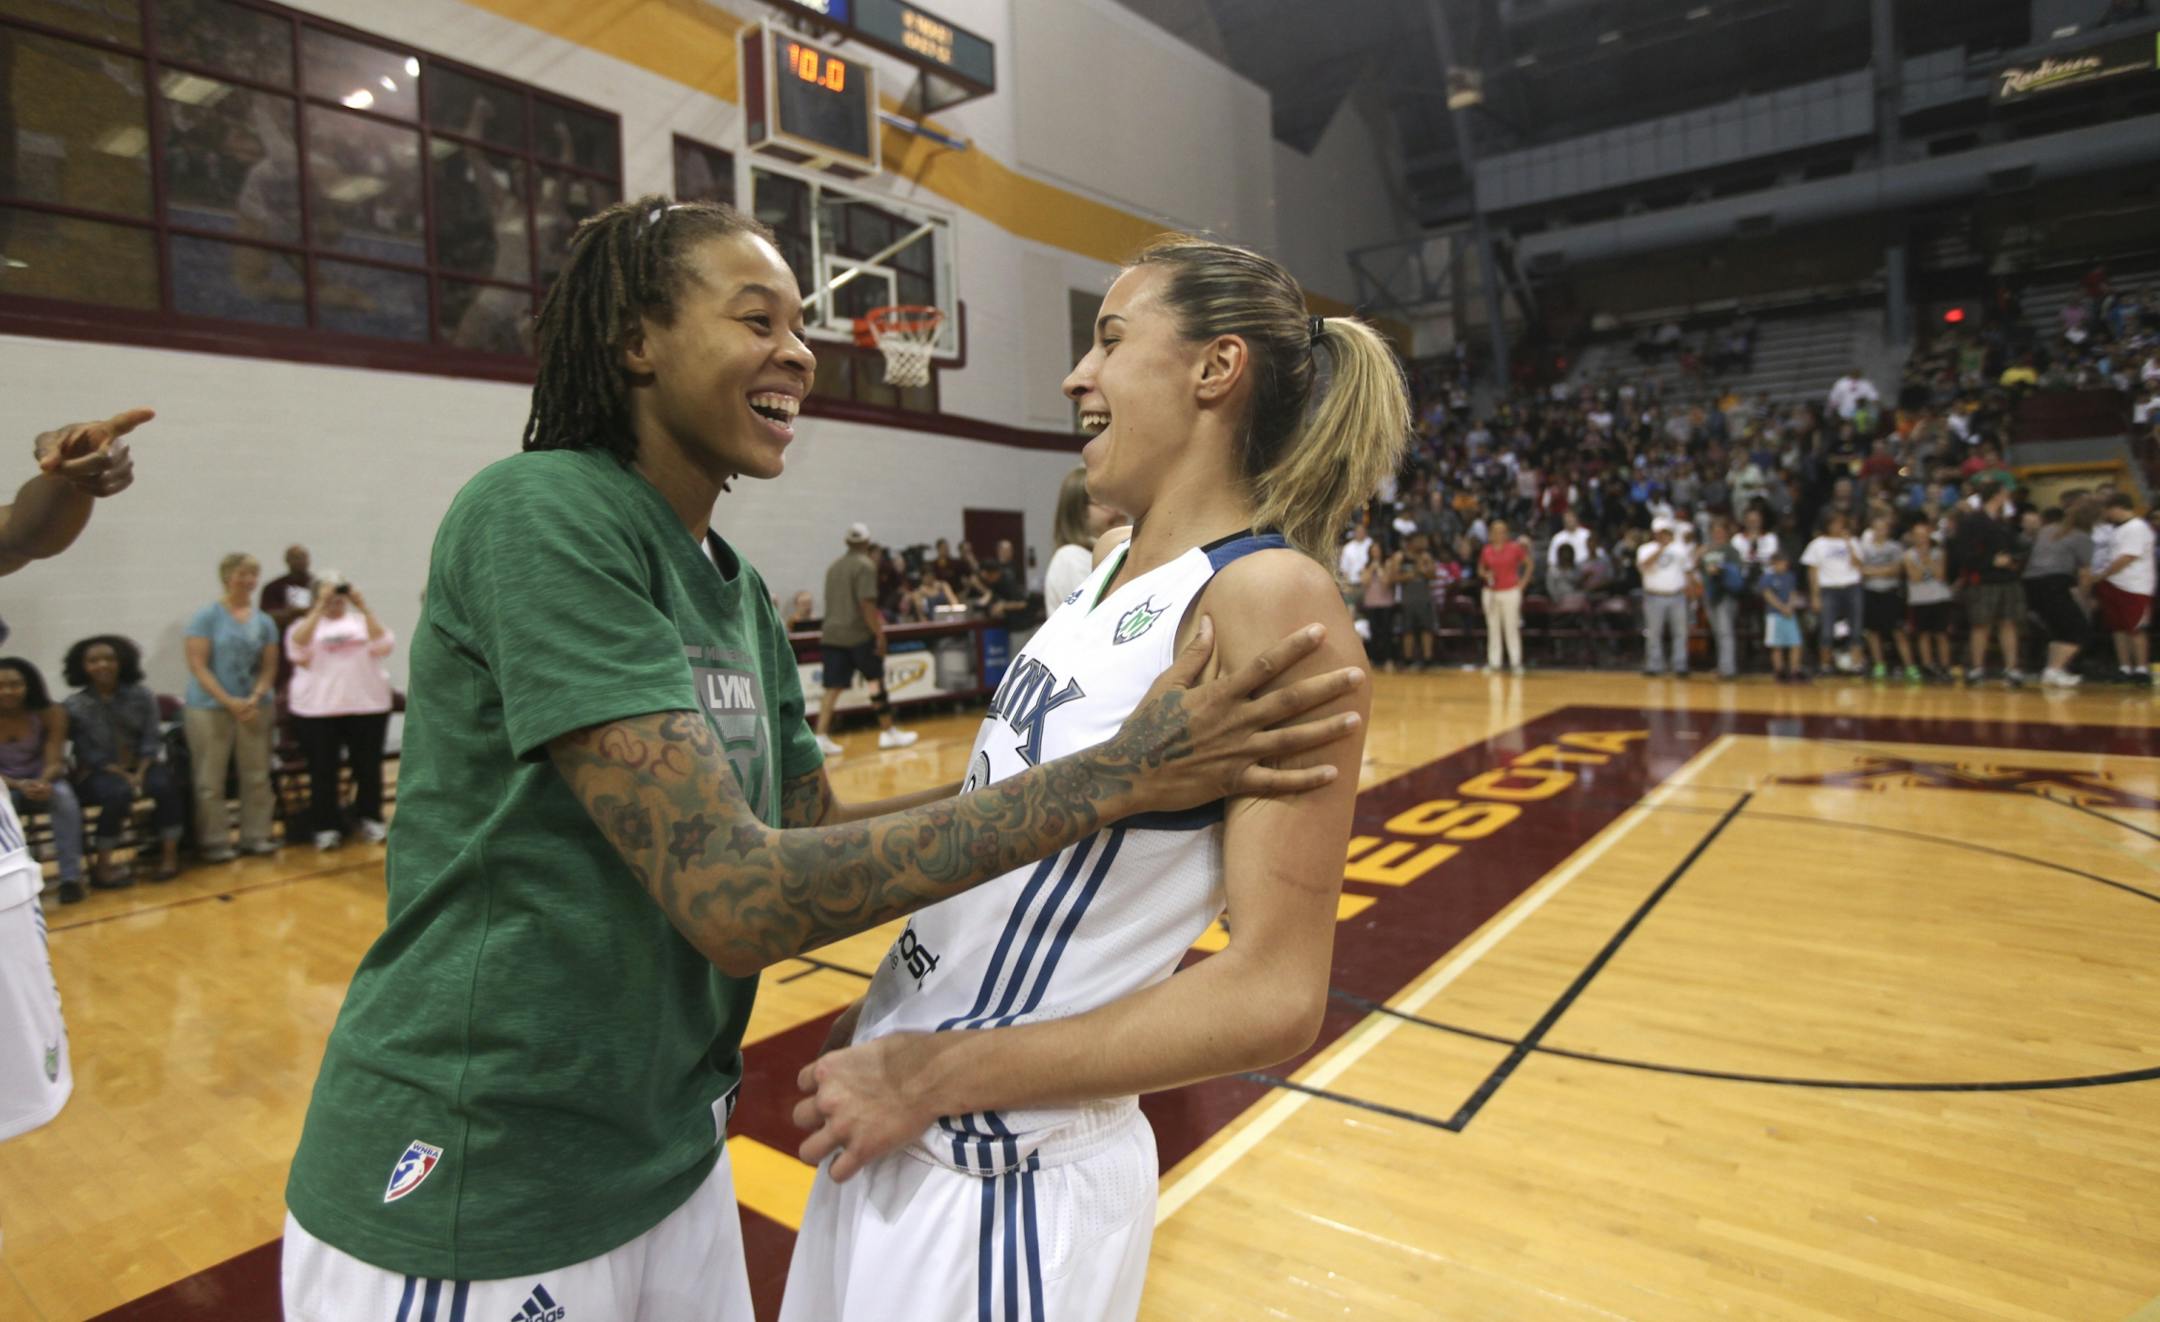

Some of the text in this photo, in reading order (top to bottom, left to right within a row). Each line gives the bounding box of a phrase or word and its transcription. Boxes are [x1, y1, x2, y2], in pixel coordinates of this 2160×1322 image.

[707, 674, 755, 709] LYNX
[1337, 730, 1650, 921] ESOTA
[899, 917, 940, 992] ost
[413, 1143, 439, 1158] WNBA
